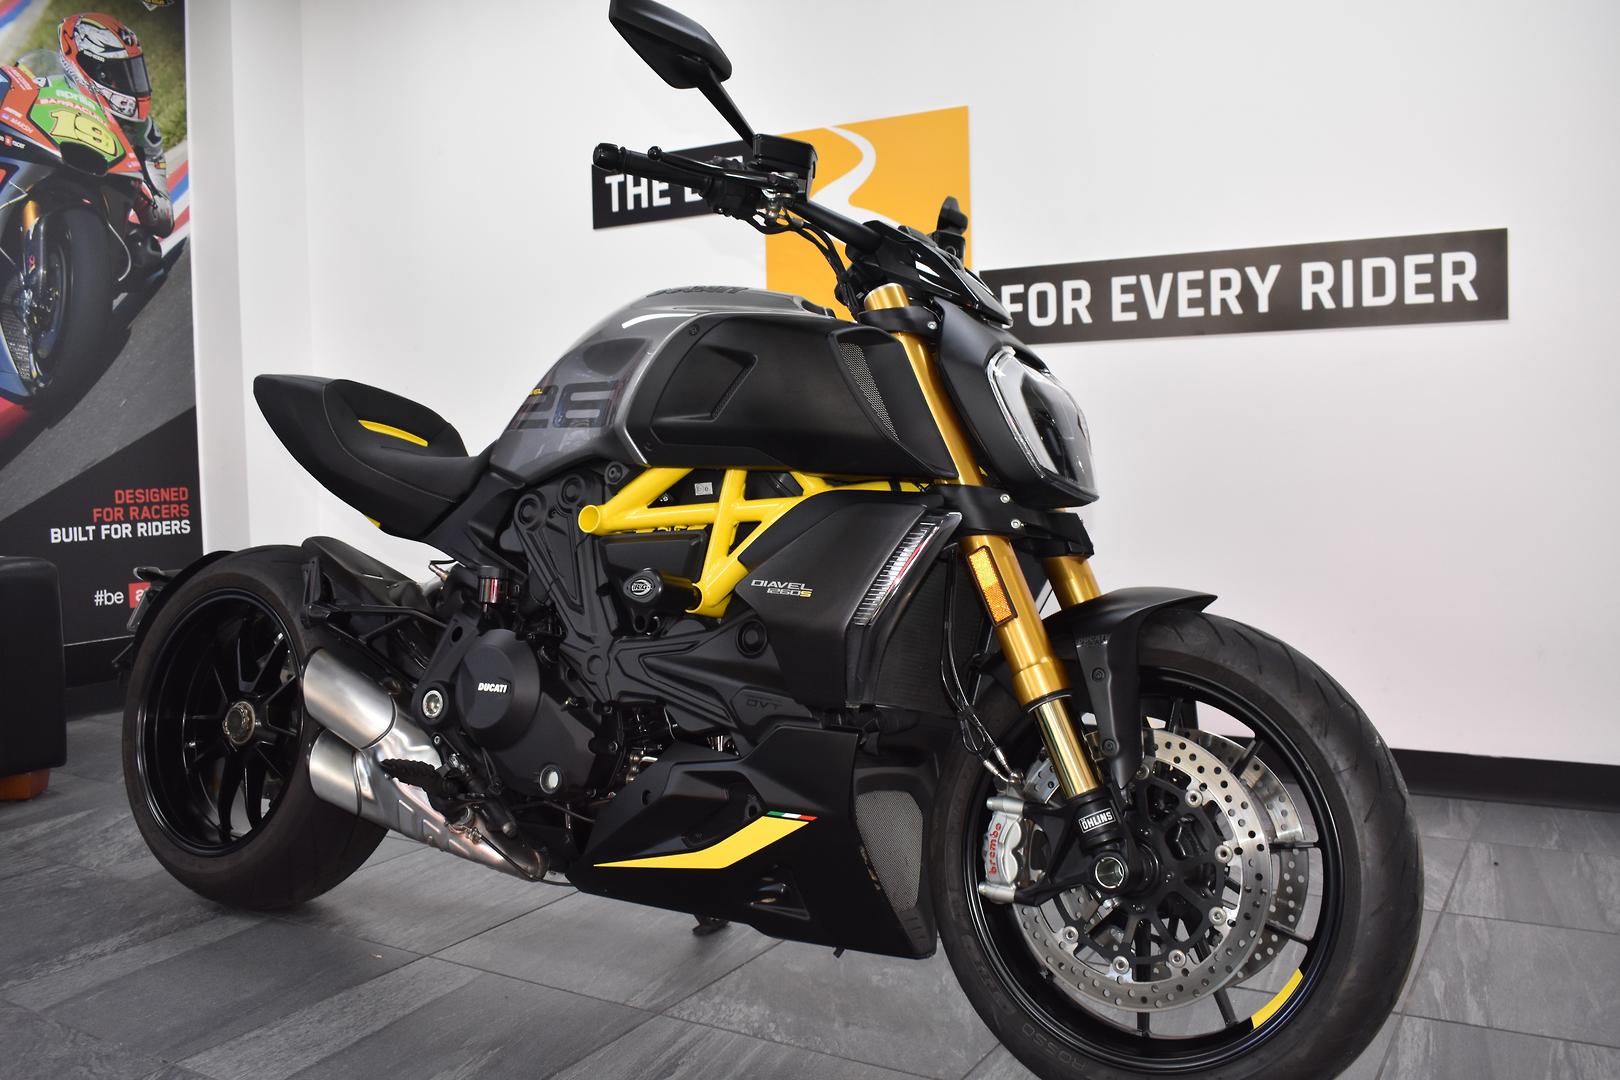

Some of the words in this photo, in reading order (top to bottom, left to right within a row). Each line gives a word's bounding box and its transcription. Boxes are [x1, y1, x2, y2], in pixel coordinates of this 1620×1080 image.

[604, 174, 671, 213] THE
[1001, 279, 1093, 327] FOR
[1111, 264, 1282, 322] EVERY
[1300, 251, 1479, 311] RIDER
[114, 487, 189, 505] DESIGNED
[93, 506, 125, 523] FOR
[129, 503, 190, 520] RACERS
[50, 525, 96, 544] BUILT
[100, 523, 133, 540] FOR
[136, 519, 191, 538] RIDERS
[750, 579, 813, 592] DIAVEL
[94, 589, 125, 607] #be
[477, 682, 508, 693] DUCATI
[1080, 811, 1114, 830] ÖHLINS
[988, 822, 1002, 876] brembo
[1021, 1023, 1088, 1071] ROSSO
